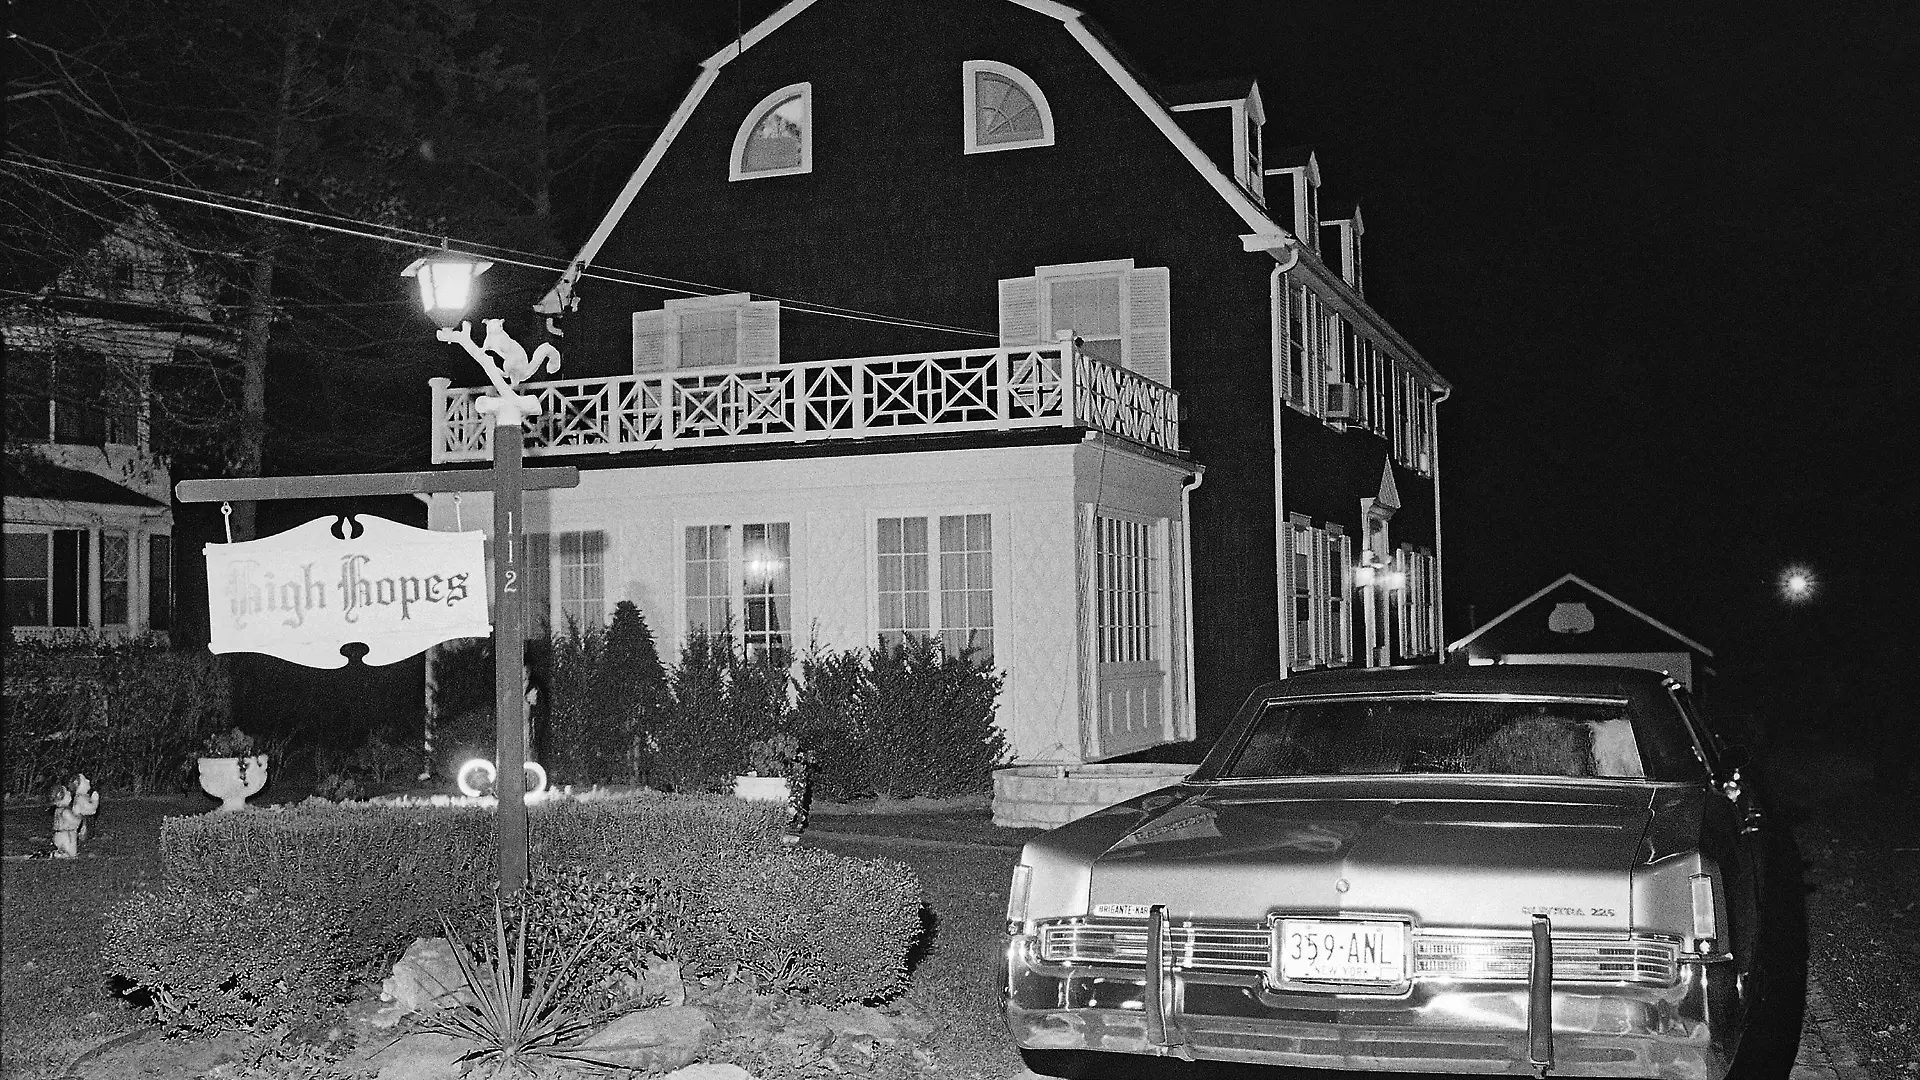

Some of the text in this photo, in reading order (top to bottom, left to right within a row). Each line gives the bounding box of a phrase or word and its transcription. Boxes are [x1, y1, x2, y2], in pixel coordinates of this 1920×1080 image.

[225, 553, 470, 631] High Hopes
[1342, 966, 1369, 977] YORK
